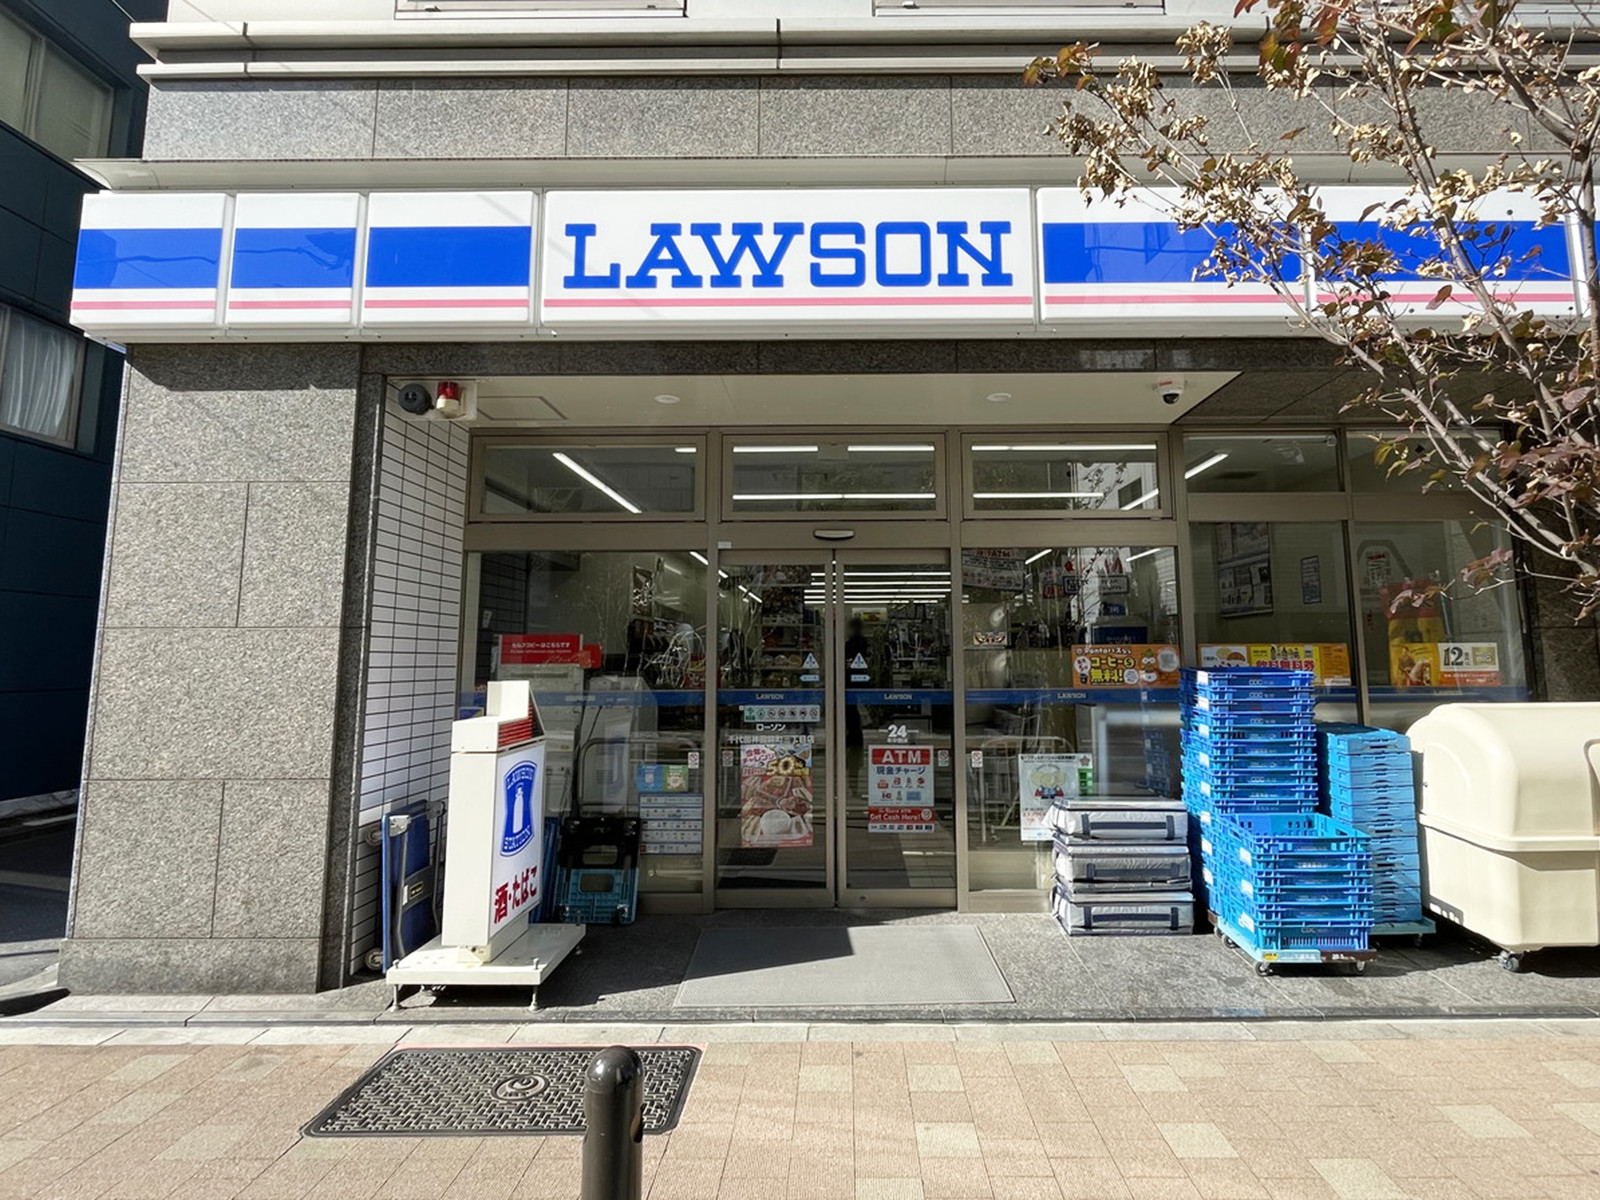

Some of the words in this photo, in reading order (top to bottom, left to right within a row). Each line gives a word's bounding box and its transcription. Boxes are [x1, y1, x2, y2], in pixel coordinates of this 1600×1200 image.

[563, 221, 1013, 288] LAWSON
[1443, 646, 1464, 666] 12
[756, 723, 786, 731] ローソン
[887, 724, 908, 738] 24
[881, 750, 922, 764] ATM
[876, 766, 926, 775] 現金チャージ
[869, 813, 882, 821] Get
[882, 813, 900, 821] Cash
